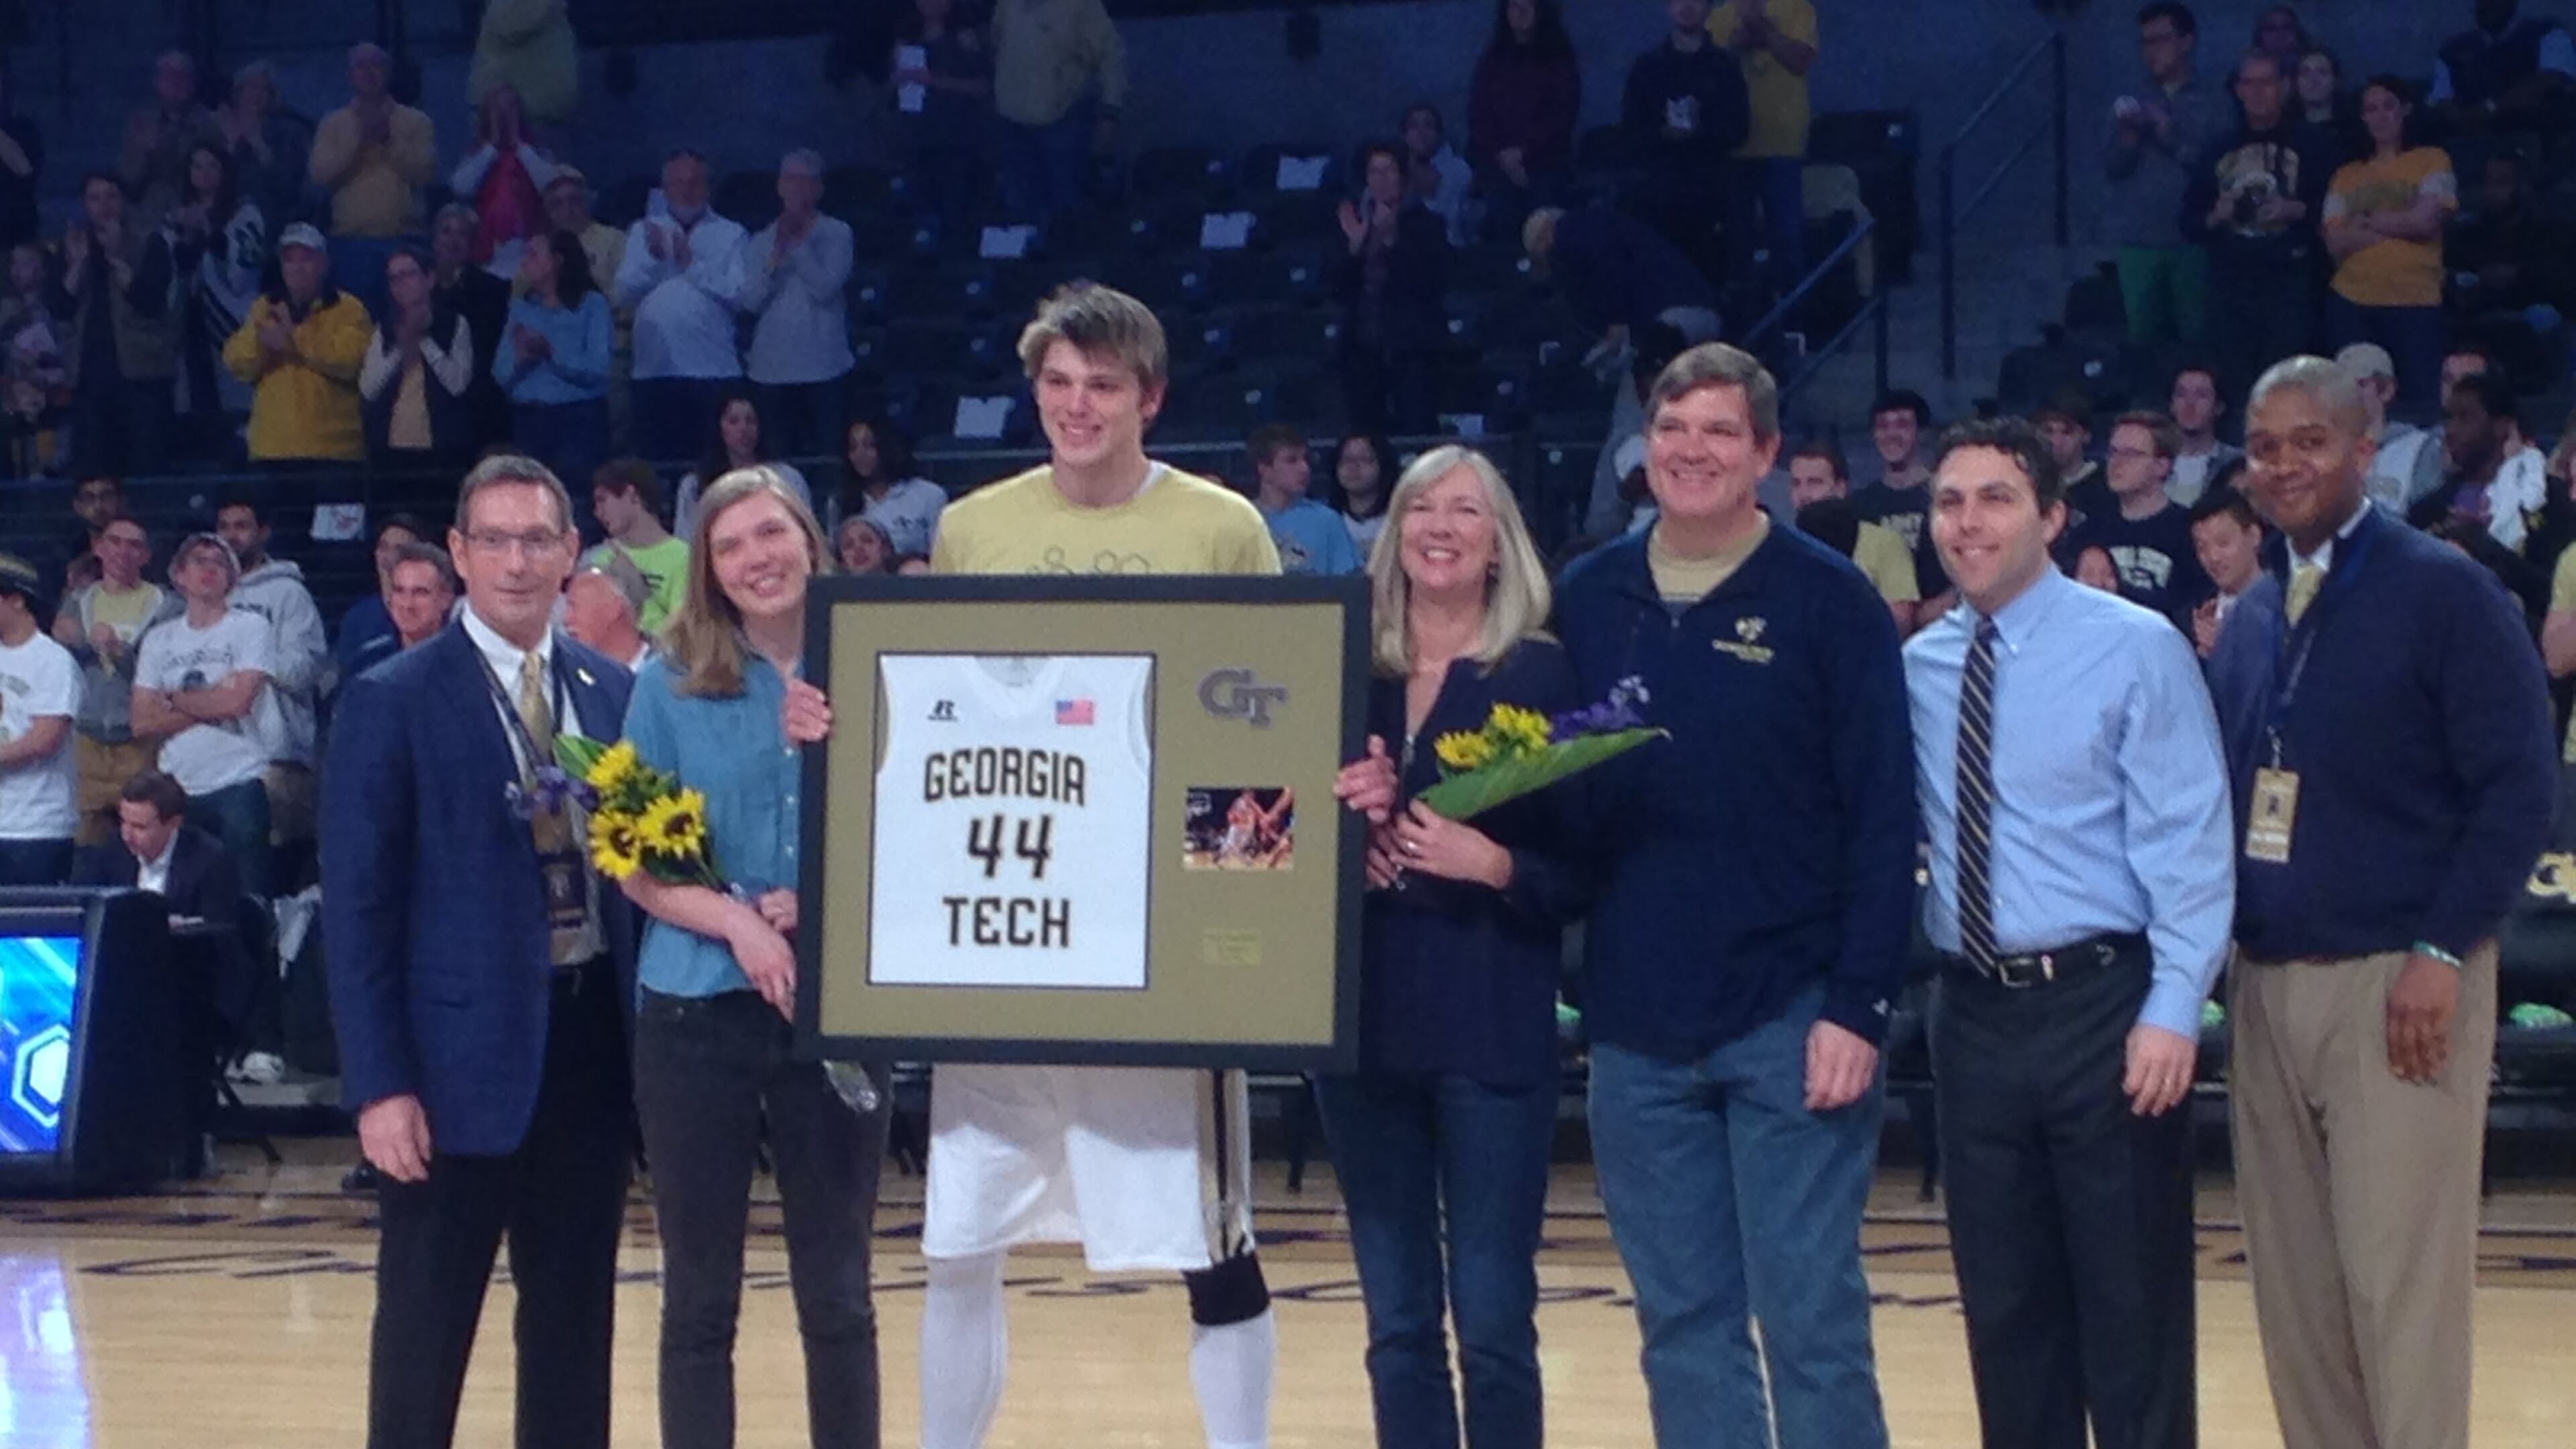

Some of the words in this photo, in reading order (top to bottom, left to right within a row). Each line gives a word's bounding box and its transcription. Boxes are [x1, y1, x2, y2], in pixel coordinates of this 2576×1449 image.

[1195, 667, 1289, 729] GT
[924, 747, 1086, 808] GEORGIA
[967, 814, 1052, 879] 44
[942, 896, 1071, 948] TECH
